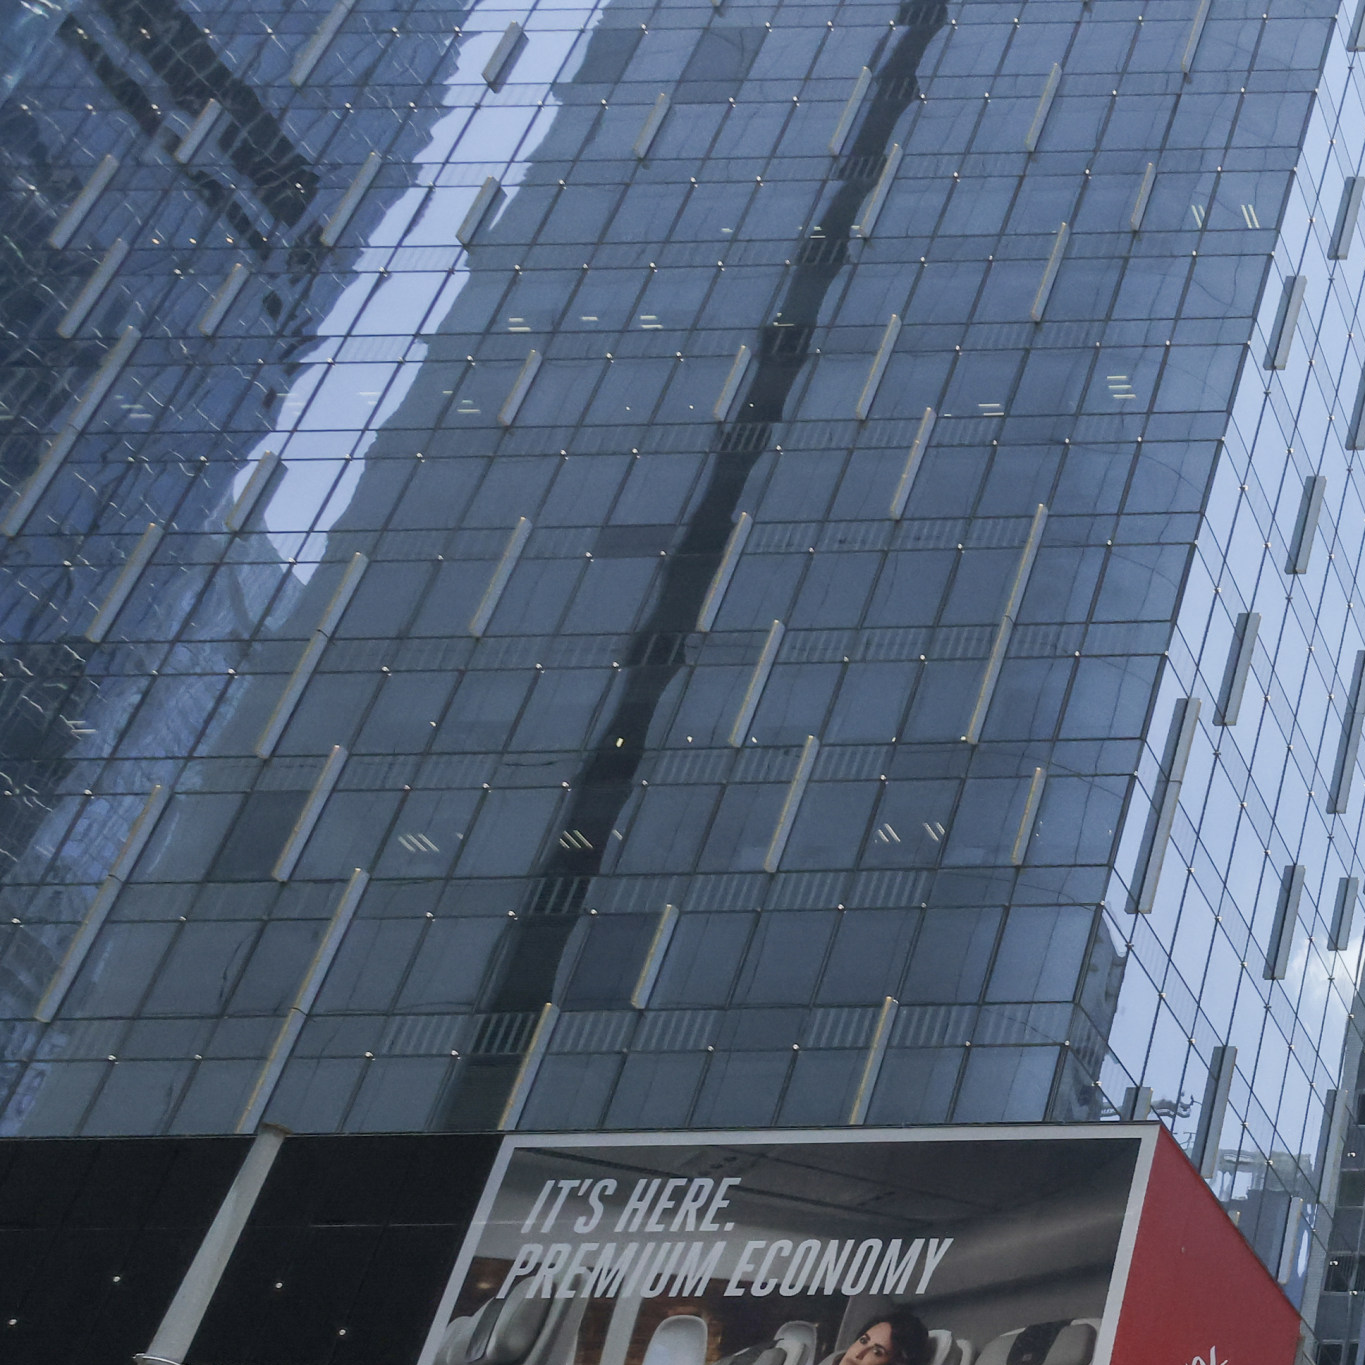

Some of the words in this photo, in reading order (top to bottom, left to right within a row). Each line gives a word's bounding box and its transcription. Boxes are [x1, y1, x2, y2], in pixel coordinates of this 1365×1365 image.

[521, 1178, 618, 1234] IT'S
[613, 1177, 742, 1232] HERE.
[496, 1241, 727, 1299] PREMIUM
[723, 1238, 954, 1297] ECONOMY
